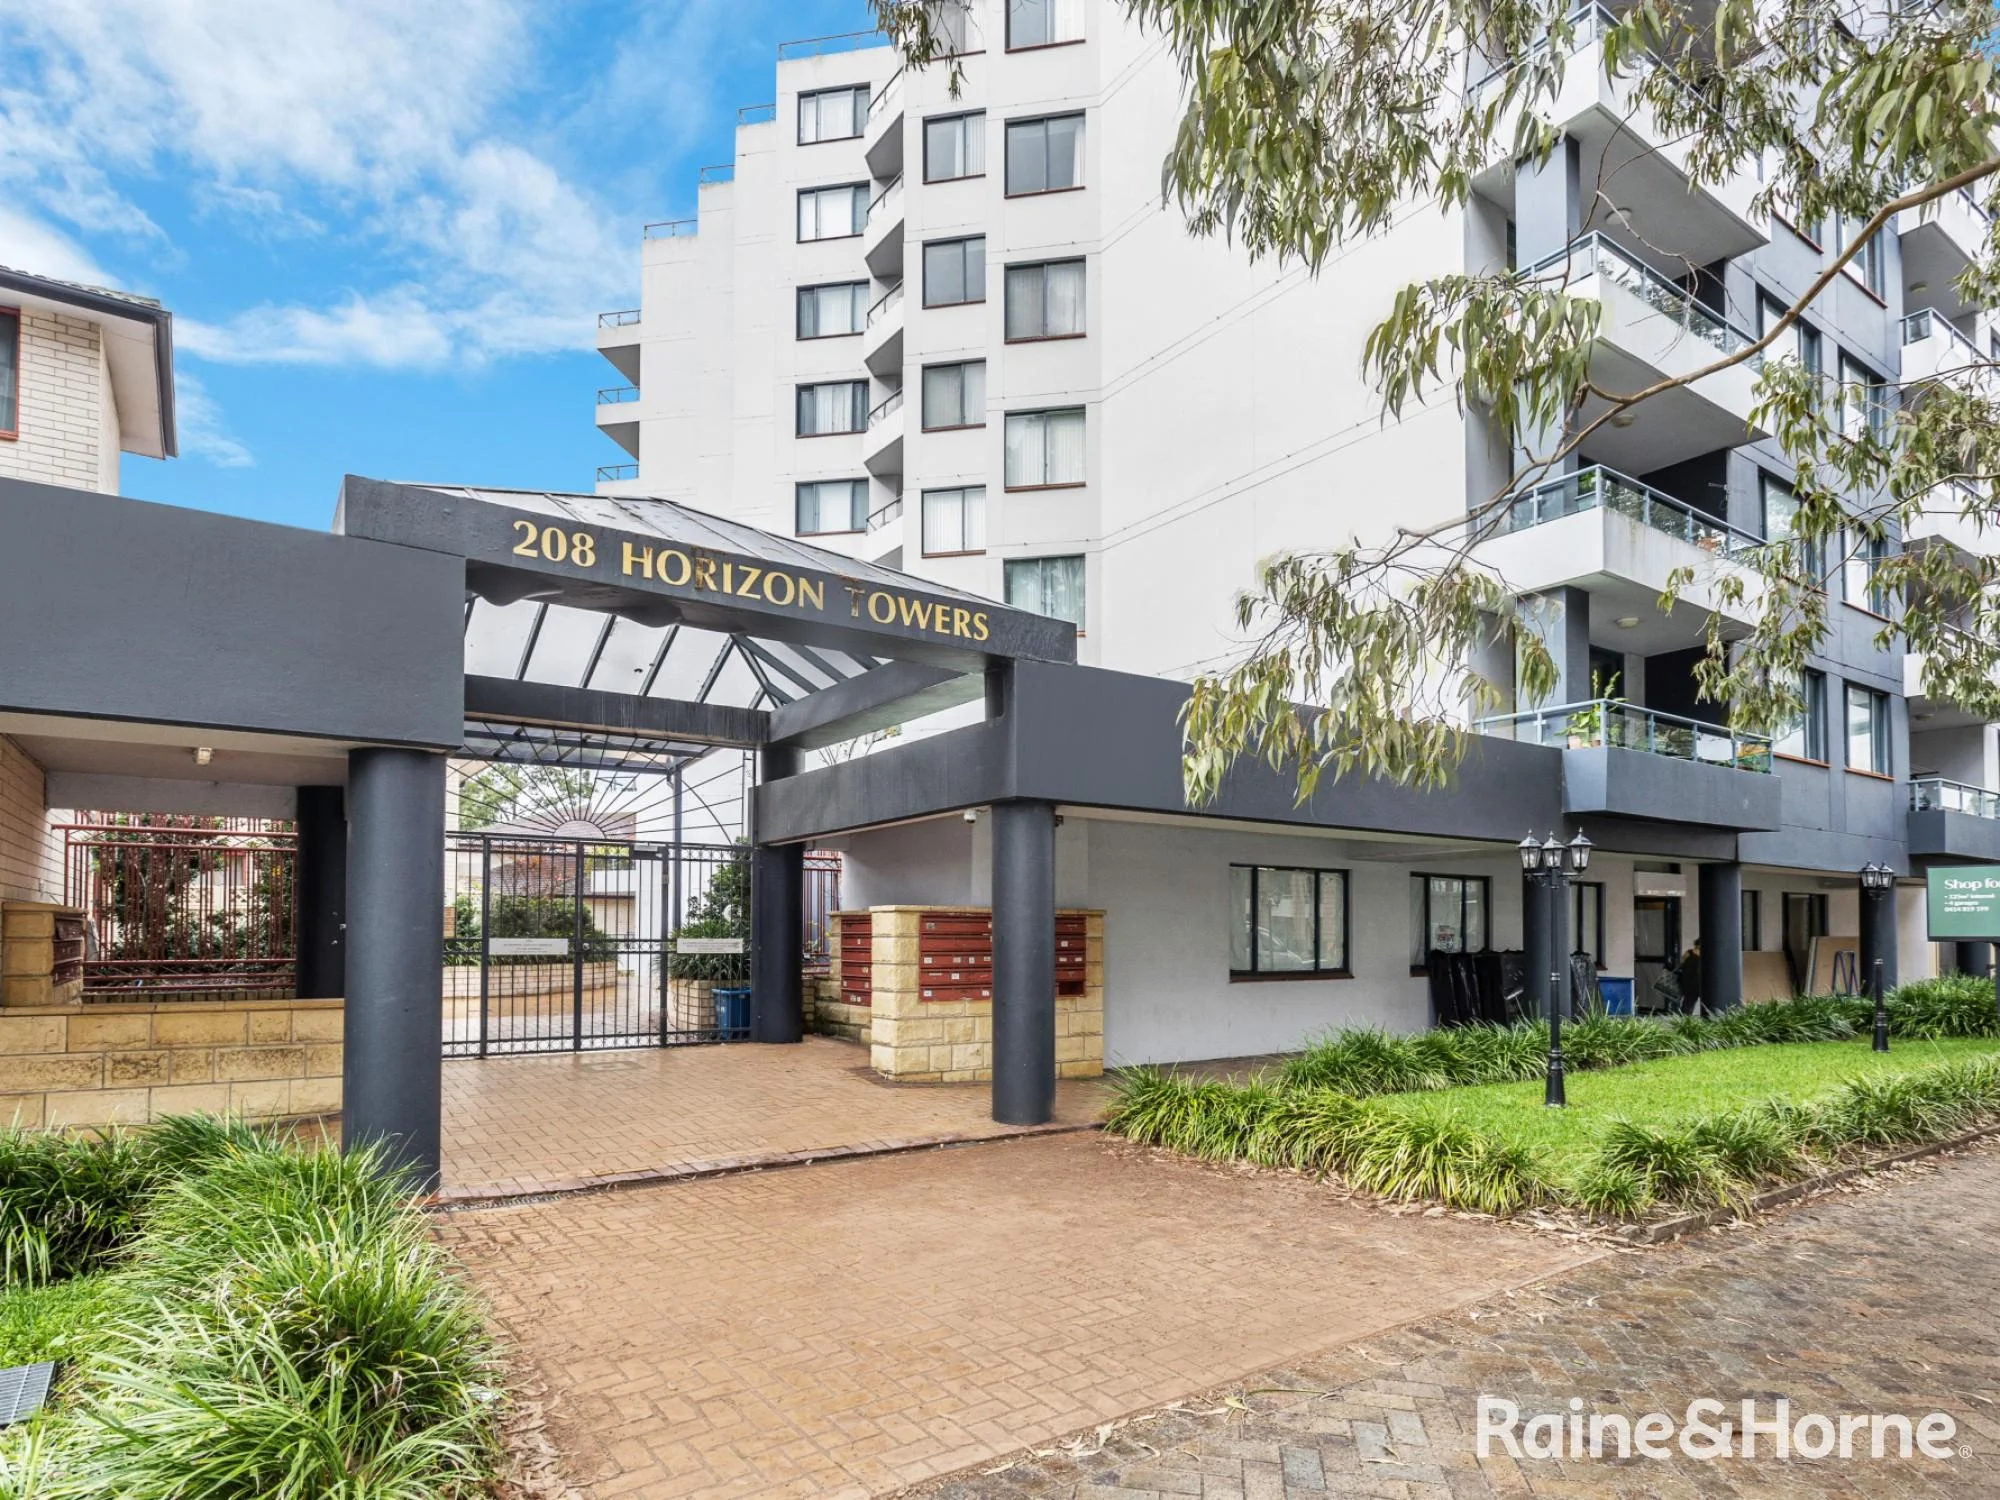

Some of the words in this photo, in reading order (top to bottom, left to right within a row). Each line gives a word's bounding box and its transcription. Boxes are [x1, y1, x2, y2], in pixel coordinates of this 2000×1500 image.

[512, 519, 597, 568] 208
[621, 541, 824, 611] HORIZON
[844, 585, 990, 642] TOWERS
[1944, 878, 1983, 891] Shop
[1984, 877, 2000, 889] fo
